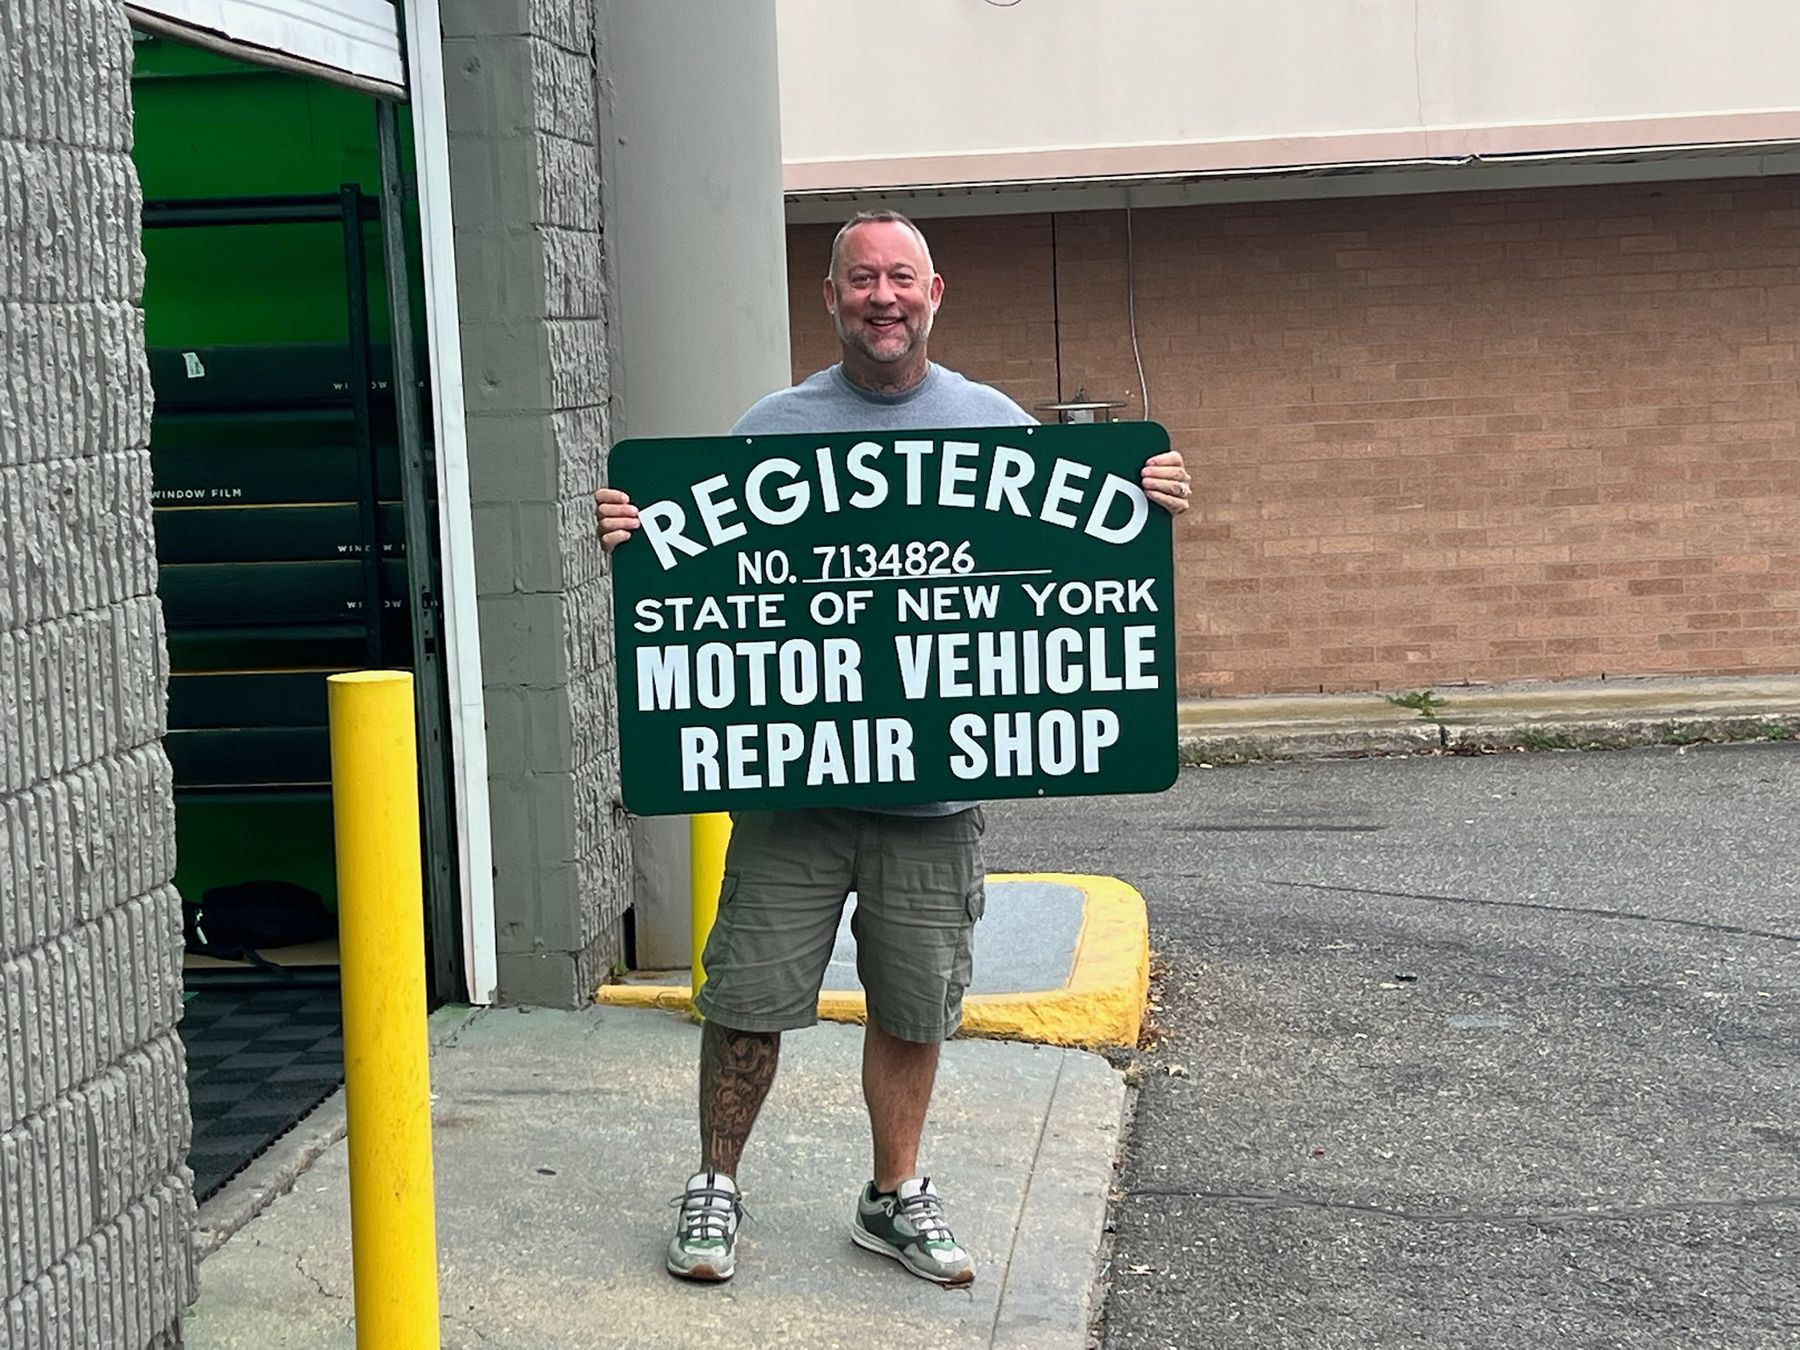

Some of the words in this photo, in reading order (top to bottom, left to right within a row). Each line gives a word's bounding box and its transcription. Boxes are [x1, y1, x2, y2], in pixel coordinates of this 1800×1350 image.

[152, 489, 206, 499] WINDOW
[211, 488, 242, 498] FILM
[638, 441, 1149, 571] REGISTERED
[738, 550, 797, 586] NO.
[813, 540, 976, 581] 7134826
[633, 592, 787, 633] STATE
[811, 590, 874, 626] OF
[898, 585, 1000, 622] NEW
[1022, 578, 1159, 617] YORK
[636, 638, 863, 711] MOTOR
[895, 625, 1160, 700] VEHICLE
[680, 717, 915, 792] REPAIR
[949, 708, 1120, 780] SHOP
